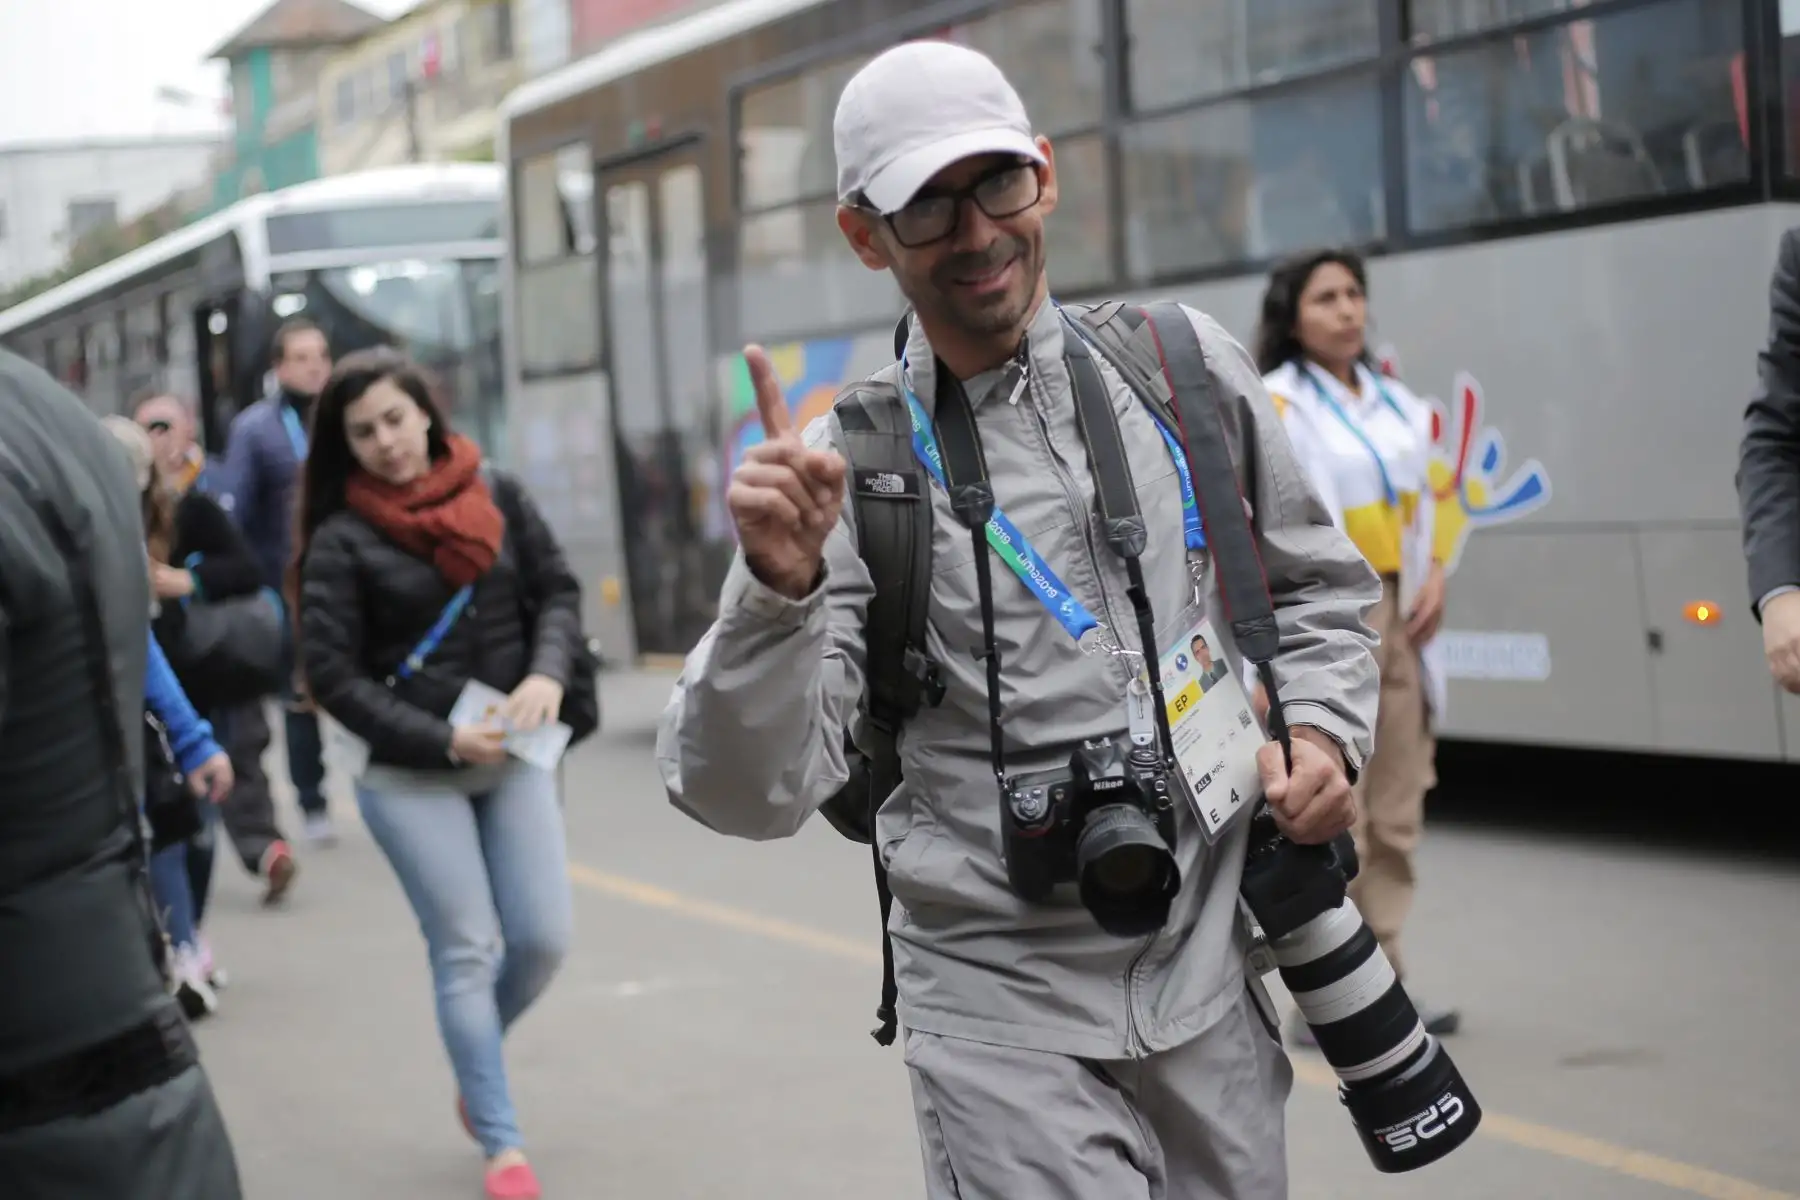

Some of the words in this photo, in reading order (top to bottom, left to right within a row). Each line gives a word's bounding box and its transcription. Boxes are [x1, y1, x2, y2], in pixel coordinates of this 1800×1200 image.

[865, 478, 891, 487] NORTH
[877, 472, 891, 480] THE
[872, 485, 892, 493] FACE
[1016, 552, 1058, 598] Lima2019
[1175, 694, 1188, 712] EP
[1093, 780, 1124, 790] Nikon
[1197, 775, 1211, 791] ALL
[1231, 787, 1240, 803] 4
[1209, 808, 1221, 824] E
[1385, 1096, 1464, 1152] CPS
